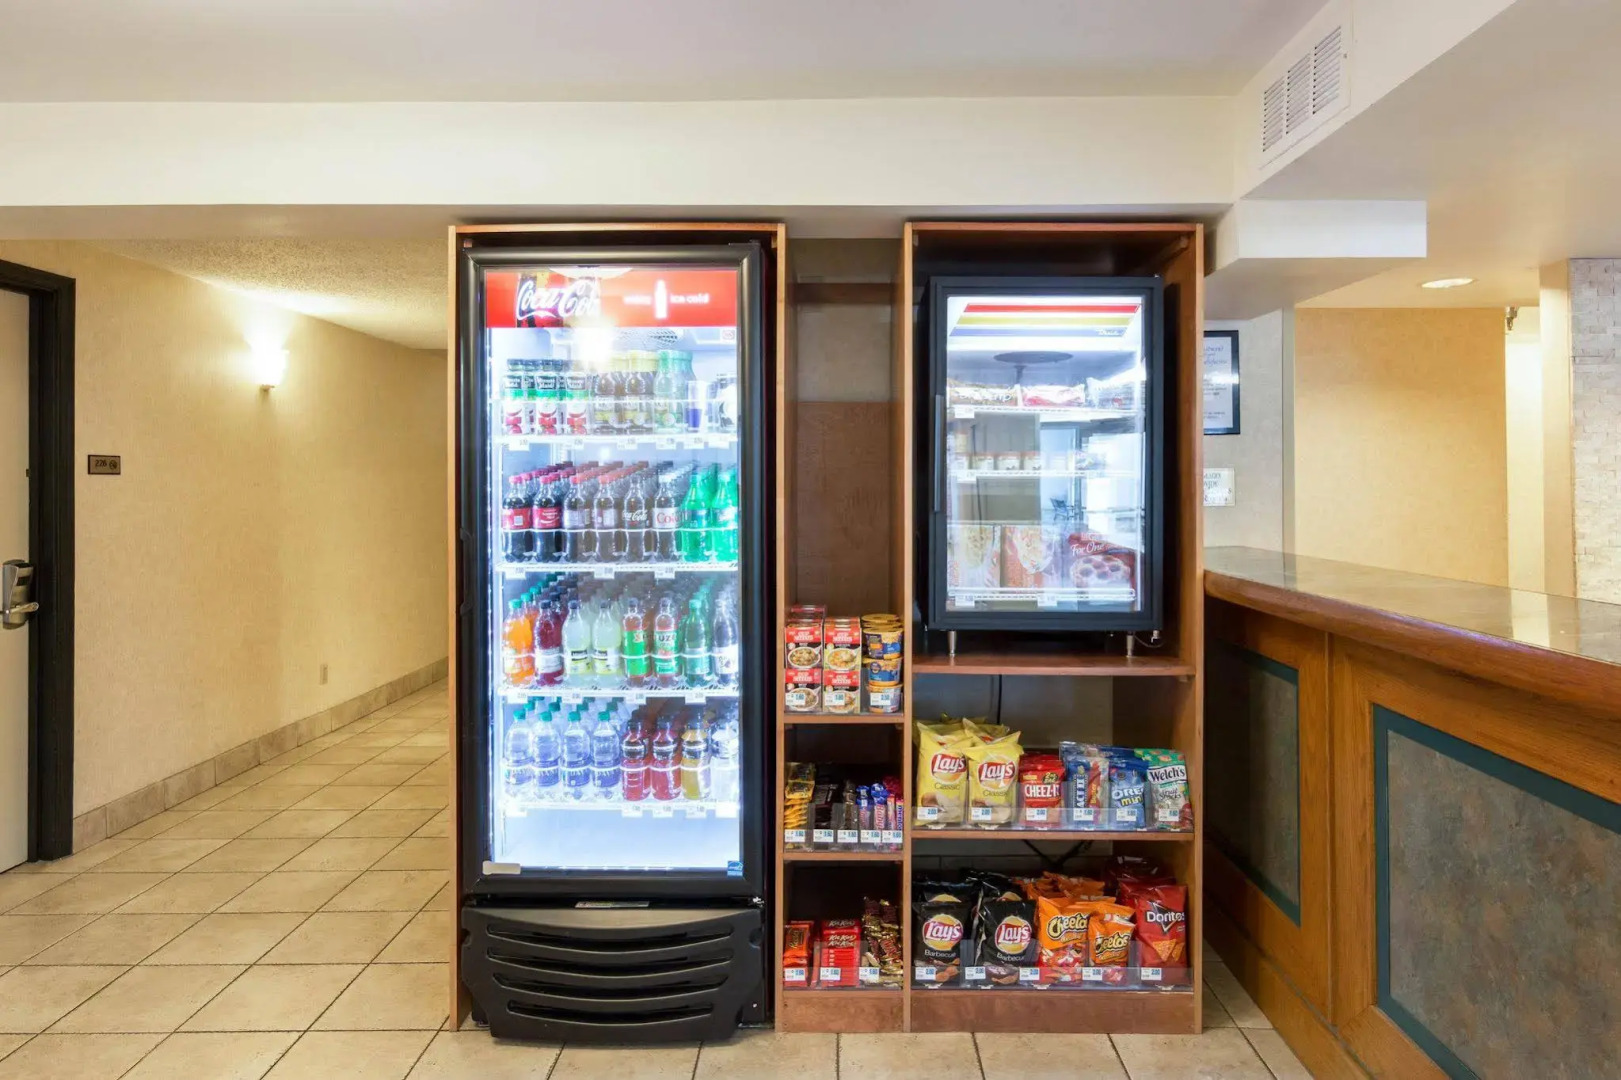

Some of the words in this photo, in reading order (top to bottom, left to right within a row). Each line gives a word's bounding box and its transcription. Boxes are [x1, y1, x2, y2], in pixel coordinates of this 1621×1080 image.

[980, 762, 1014, 781] Lay's
[1149, 766, 1185, 782] Welch's
[926, 921, 962, 942] Lay's
[998, 923, 1030, 945] Lay's
[1047, 913, 1088, 939] Cheeto
